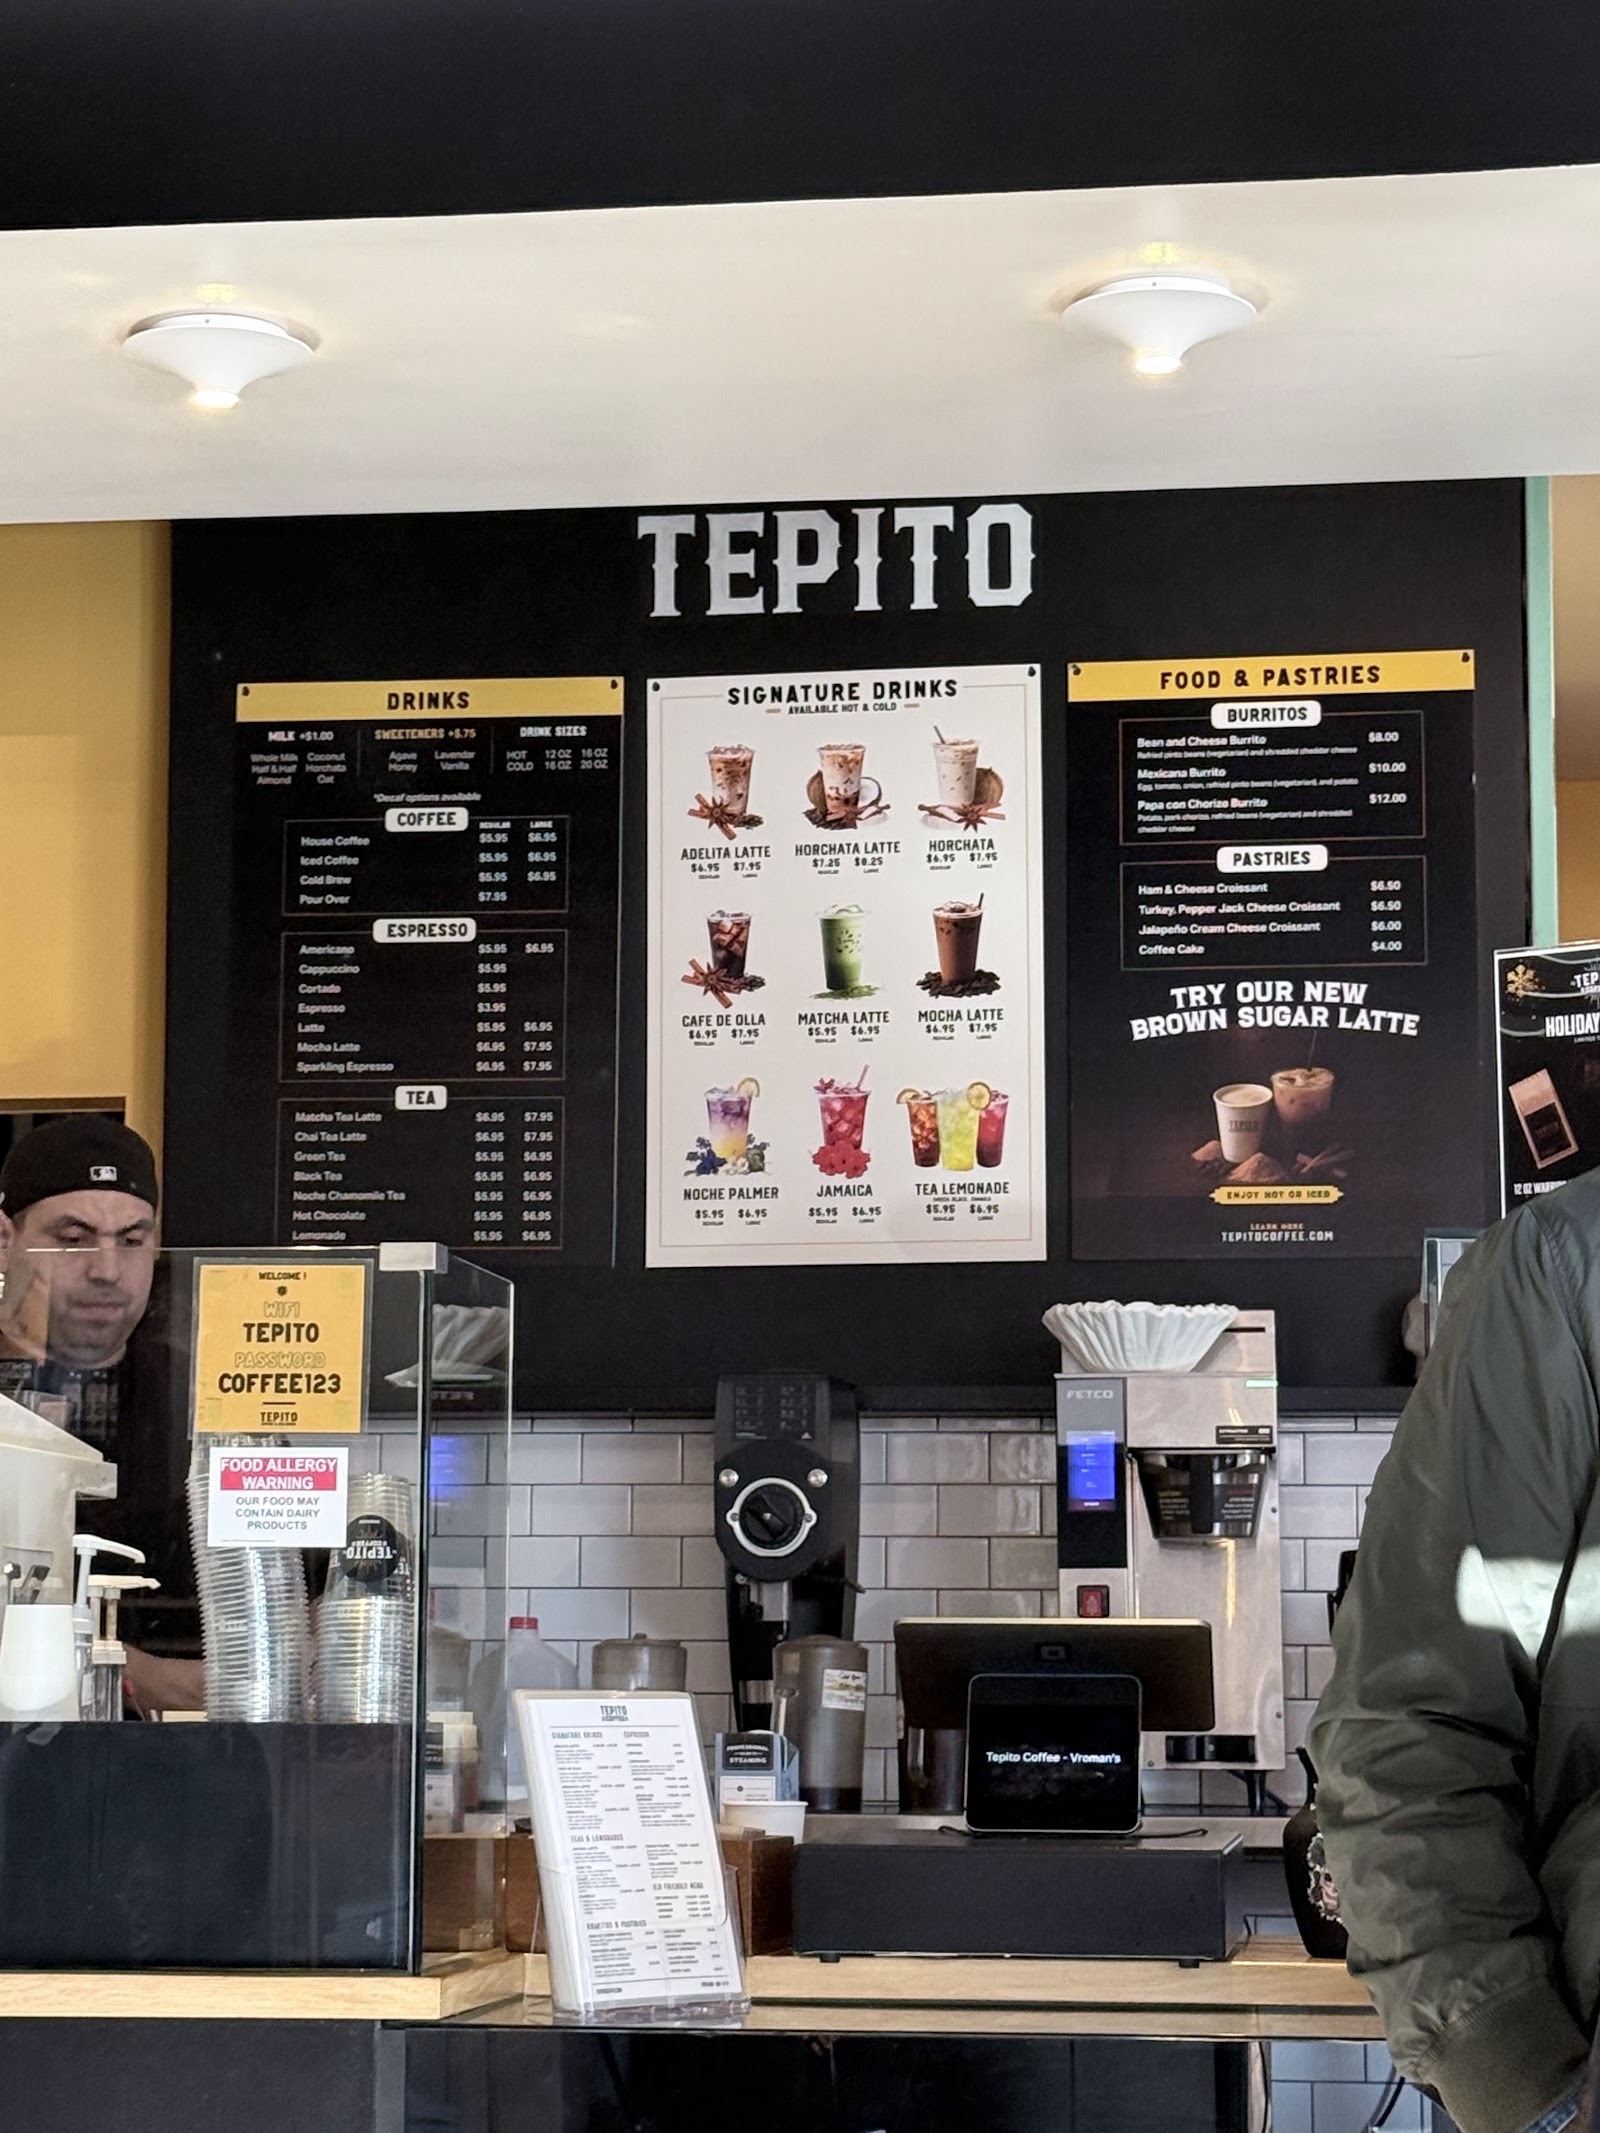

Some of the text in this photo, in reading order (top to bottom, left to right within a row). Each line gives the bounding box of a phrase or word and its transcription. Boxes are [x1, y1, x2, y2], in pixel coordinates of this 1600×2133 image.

[637, 503, 1036, 617] TEPITO
[1160, 665, 1381, 690] FOOD & PASTRIES
[727, 679, 958, 705] SIGNATURE DRINKS
[387, 691, 470, 711] DRINKS
[788, 702, 897, 715] AVAILABLE HOT & COLD
[1227, 707, 1308, 722] BURRITOS
[268, 731, 296, 742] MILK
[374, 728, 445, 740] SWEETENERS
[519, 725, 588, 737] DRINK SIZES
[1137, 731, 1399, 748] Bean and Cheese Burrito $8.00
[506, 750, 528, 760] HOT
[506, 761, 534, 771] COLD
[1137, 762, 1406, 779] Mexicana Burrito $10.00
[1137, 793, 1407, 811] Papa con Chorizo Burrito $12.00
[397, 812, 457, 827] COFFEE
[301, 832, 557, 846] House Coffee $5.95 $6.95
[928, 838, 995, 852] HORCHATA
[680, 845, 771, 861] ADELITA LATTE
[795, 841, 901, 857] HORCHATA LATTE
[300, 852, 557, 866] Iced Coffee $5.95 $6.95
[812, 858, 841, 868] $7.25
[926, 852, 998, 864] $6.95 $7.95
[1232, 851, 1311, 867] PASTRIES
[690, 861, 762, 873] $6.95 $7.95
[300, 875, 324, 885] Cold
[1138, 880, 1401, 895] Ham & Cheese Croissant $6.50
[1178, 904, 1217, 915] Pepper
[1218, 903, 1245, 913] Jack
[1246, 902, 1287, 912] Cheese
[1288, 901, 1341, 911] Croissant
[1370, 900, 1401, 911] $6.50
[387, 923, 468, 937] ESPRESSO
[1138, 920, 1402, 936] Jalapeño Cream Cheese Croissant $6.00
[1138, 941, 1402, 955] Coffee Cake $4.00
[1169, 981, 1368, 1010] TRY OUR NEW
[682, 1013, 766, 1027] CAFE DE OLLA
[798, 1011, 890, 1025] MATCHA LATTE
[918, 1008, 1004, 1023] MOCHA LATTE
[925, 1023, 998, 1034] $6.95 $7.95
[1129, 1005, 1420, 1041] BROWN SUGAR LATTE
[1545, 1012, 1600, 1038] HOLIDAY
[688, 1028, 760, 1040] $6.95 $7.95
[807, 1025, 880, 1037] $5.95 $6.95
[406, 1091, 435, 1105] TEA
[355, 1112, 382, 1121] Latte
[477, 1112, 505, 1122] $6.95
[524, 1111, 553, 1122] $7.95
[683, 1187, 779, 1201] NOCHE PALMER
[816, 1184, 873, 1197] JAMAICA
[915, 1182, 1010, 1196] TEA LEMONADE
[1227, 1190, 1330, 1199] ENJOY HOT OR ICED
[695, 1208, 768, 1219] $5.95 $6.95
[808, 1205, 882, 1217] $5.95 $6.95
[926, 1203, 1000, 1214] $5.95 $6.95
[1221, 1231, 1334, 1242] TEPITOCOFFEE.COM
[258, 1272, 301, 1280] WELCOME
[263, 1301, 301, 1318] WIFI
[243, 1322, 319, 1343] TEPITO
[234, 1351, 326, 1369] PASSWORD
[218, 1372, 341, 1394] COFFEE123
[1066, 1389, 1114, 1399] FETCO
[260, 1411, 298, 1422] TEPITO
[221, 1458, 337, 1472] FOOD ALLERGY
[242, 1476, 314, 1490] WARNING
[236, 1496, 320, 1505] OUR FOOD MAY
[235, 1508, 320, 1517] CONTAIN DAIRY
[247, 1521, 307, 1530] PRODUCTS
[346, 1546, 393, 1559] TEPITO
[600, 1705, 627, 1716] TEPITO
[986, 1751, 1021, 1764] Tepito
[1023, 1751, 1061, 1763] Coffee
[1069, 1752, 1121, 1764] Vroman's
